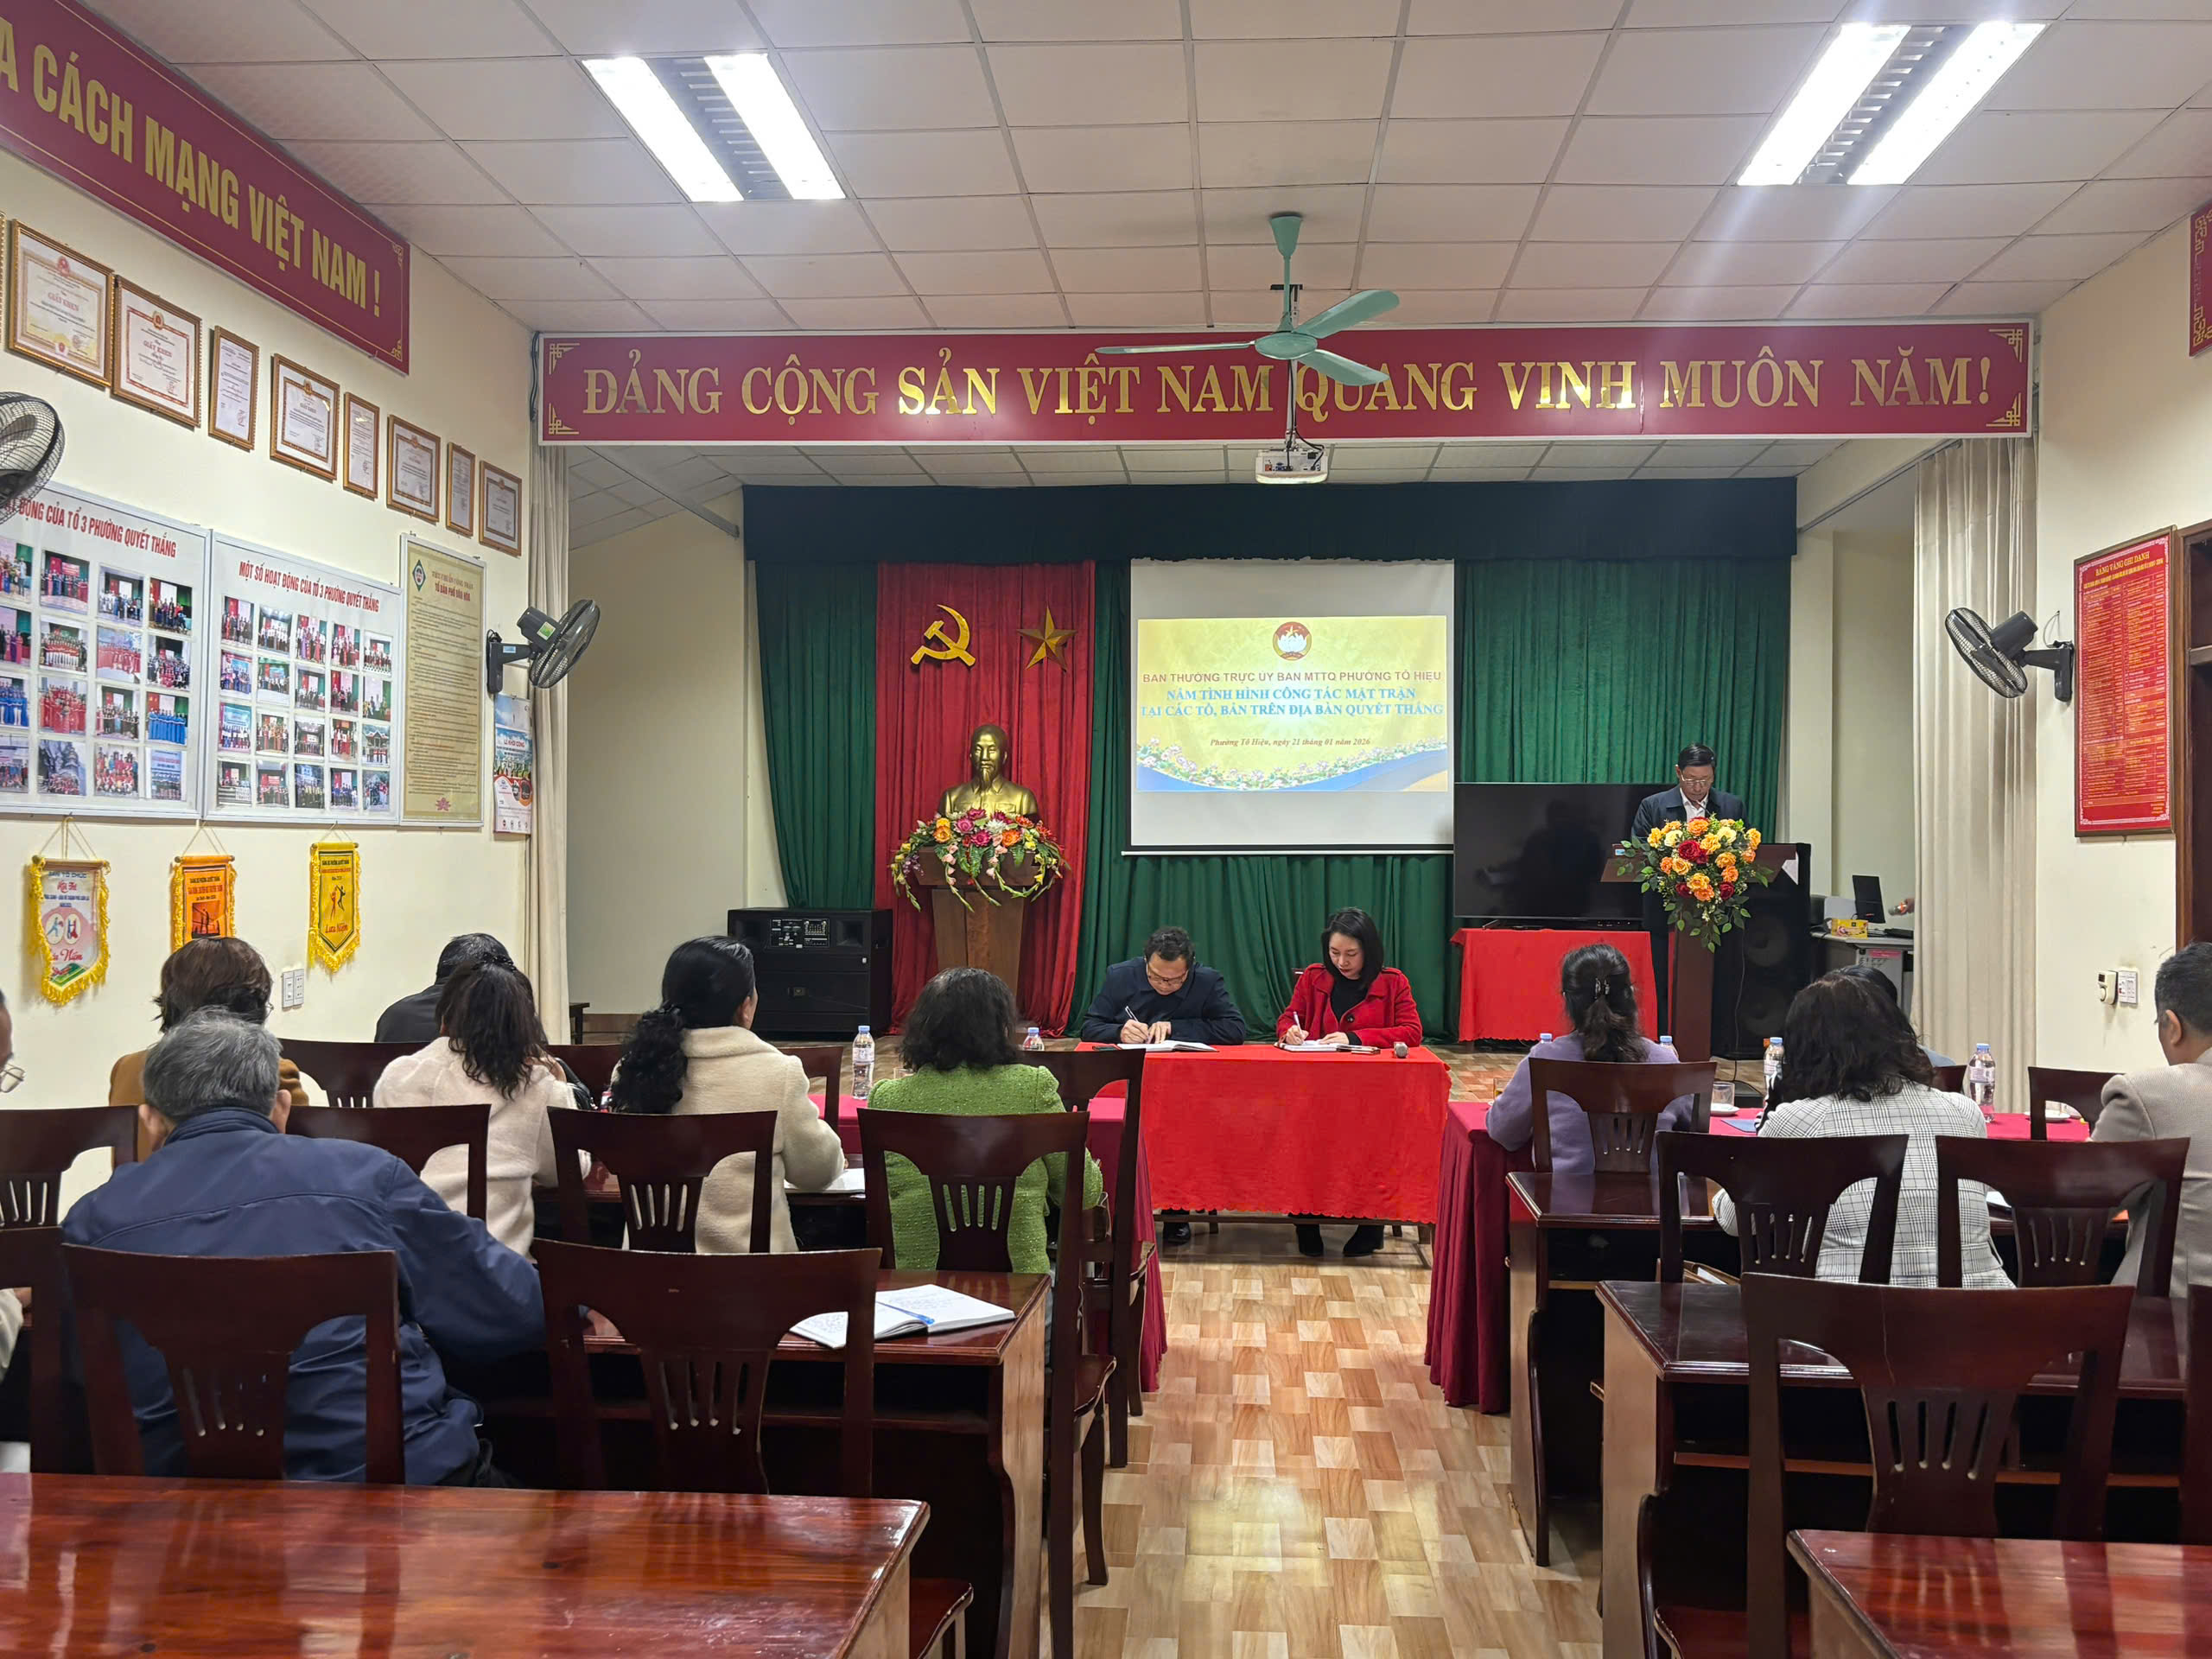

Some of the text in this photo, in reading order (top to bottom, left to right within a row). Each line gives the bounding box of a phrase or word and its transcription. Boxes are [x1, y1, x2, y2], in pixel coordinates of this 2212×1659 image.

[33, 43, 133, 164] CÁCH
[144, 114, 240, 230] MẠNG
[248, 184, 305, 272] VIỆT
[311, 228, 367, 309] NAM
[582, 348, 723, 415] ĐẢNG
[741, 353, 880, 426] CỘNG
[898, 347, 1001, 415] SẢN
[1016, 353, 1141, 426] VIỆT
[1156, 364, 1274, 413] NAM
[1295, 361, 1478, 423] QUANG
[1497, 360, 1637, 410] VINH
[1659, 345, 1824, 409] MUÔN
[46, 500, 65, 527] CỦA
[67, 506, 82, 531] TỔ
[80, 515, 87, 533] 3
[88, 518, 124, 543] PHƯỜNG
[124, 528, 151, 550] QUYẾT
[151, 531, 177, 558] THẮNG
[238, 560, 254, 582] MỘT
[254, 562, 265, 582] SỐ
[264, 569, 282, 588] HOẠT
[282, 572, 300, 593] ĐỘNG
[300, 575, 312, 595] CỦA
[319, 584, 324, 598] 3
[323, 585, 346, 604] PHƯỜNG
[346, 590, 363, 608] QUYẾT
[362, 593, 379, 613] THẮNG
[1142, 673, 1167, 683] BAN
[1170, 672, 1220, 683] THƯỜNG
[1223, 671, 1255, 684] TRỰC
[1258, 671, 1274, 682] ỦY
[1277, 672, 1301, 682] BAN
[1304, 672, 1337, 682] MTTQ
[1339, 671, 1392, 682] PHƯỜNG
[1414, 671, 1442, 683] HIỆU
[1199, 687, 1233, 700] TÌNH
[1235, 687, 1270, 700] HÌNH
[1272, 686, 1312, 700] CÔNG
[1313, 686, 1342, 700] TÁC
[1345, 688, 1376, 702] MẶT
[1378, 687, 1417, 701] TRẬN
[1141, 705, 1162, 718] TẠI
[1165, 702, 1193, 715] CÁC
[1220, 702, 1247, 715] BẢN
[1250, 702, 1286, 715] TRÊN
[1288, 703, 1313, 717] ĐỊA
[1314, 702, 1343, 715] BÀN
[1344, 702, 1392, 717] QUYẾT
[1394, 702, 1444, 715] THẮNG
[1251, 738, 1272, 747] Hiệu,
[1273, 739, 1291, 747] ngày
[1301, 738, 1323, 747] tháng
